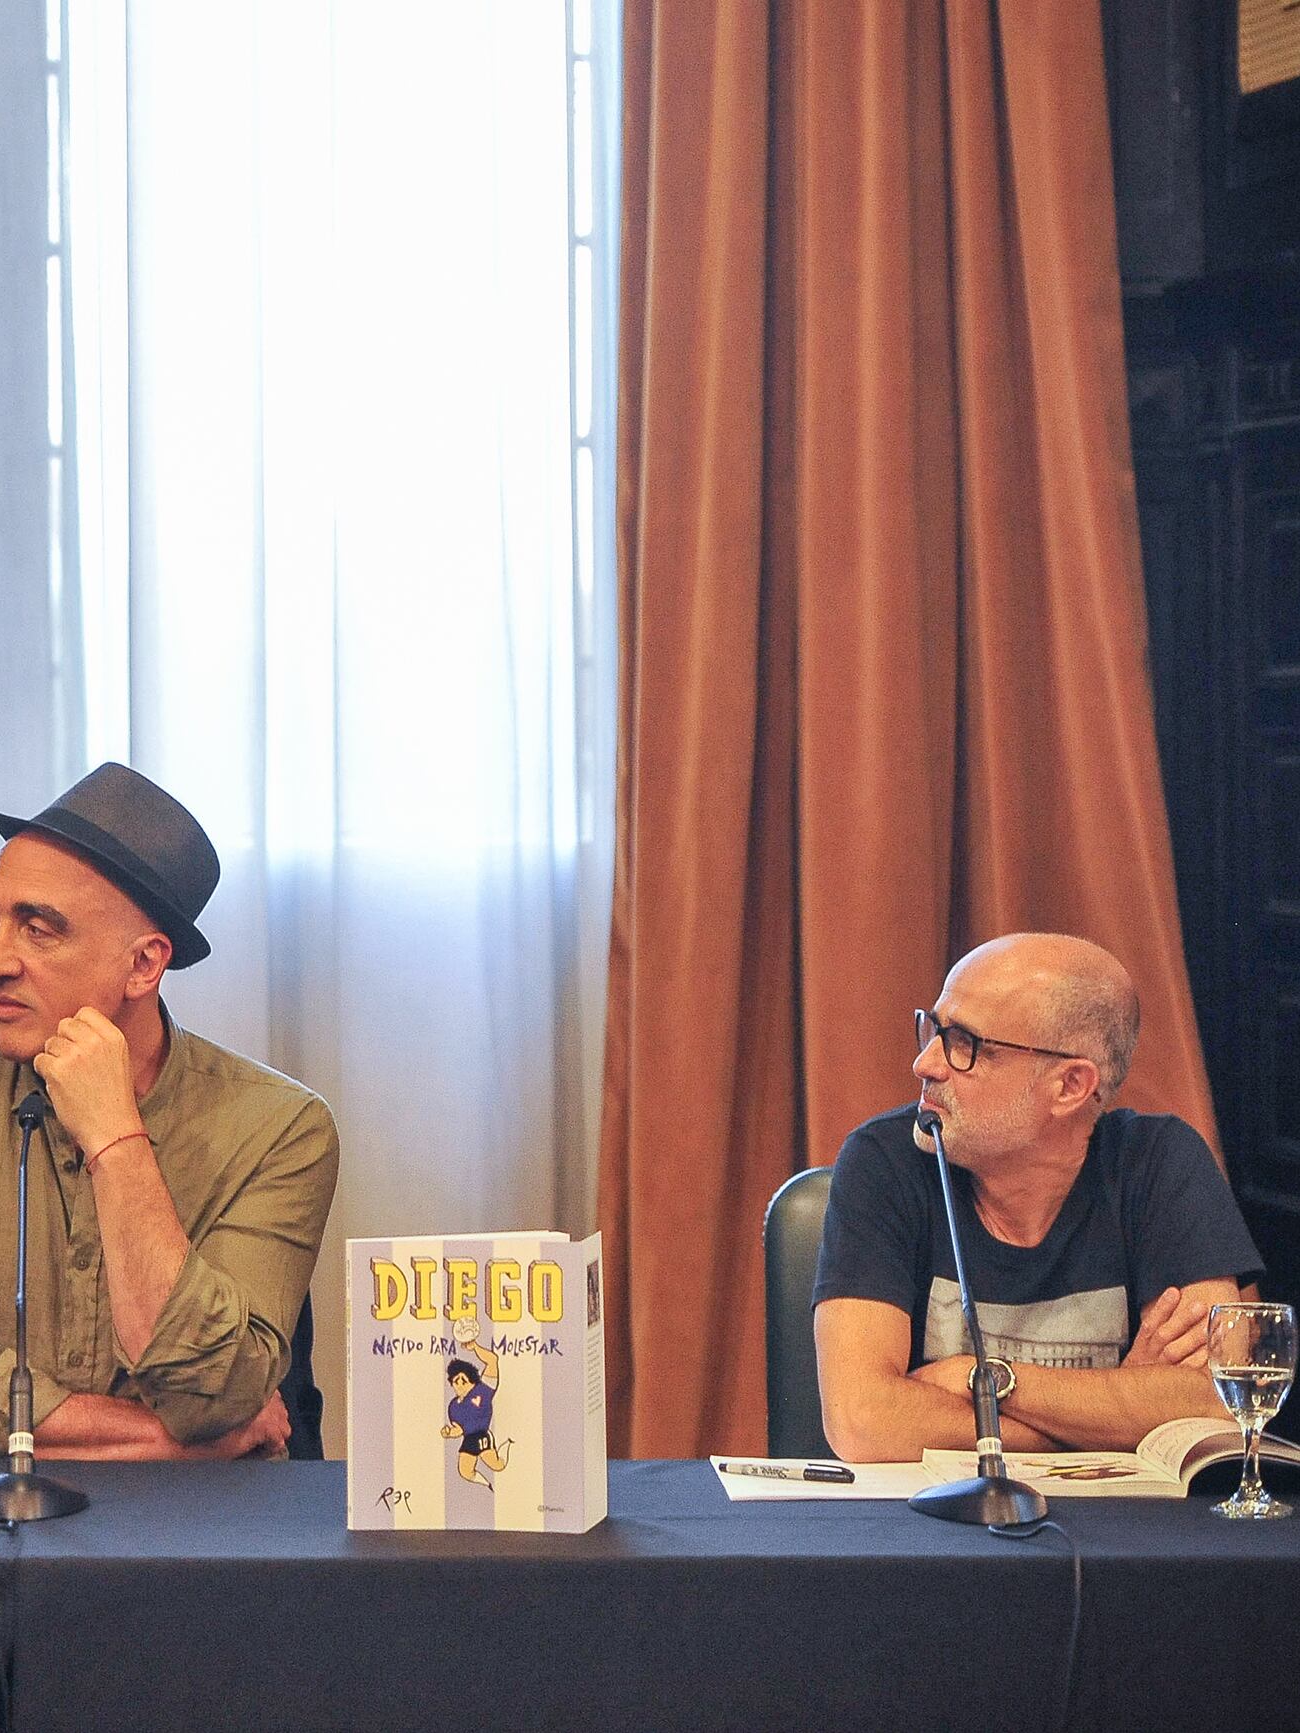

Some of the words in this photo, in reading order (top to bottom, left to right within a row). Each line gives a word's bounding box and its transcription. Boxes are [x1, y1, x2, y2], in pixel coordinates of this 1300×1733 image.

[371, 1257, 564, 1323] DIEGO
[372, 1334, 424, 1358] NACIDO
[430, 1335, 457, 1356] PARA
[491, 1333, 564, 1357] MOLESTAR
